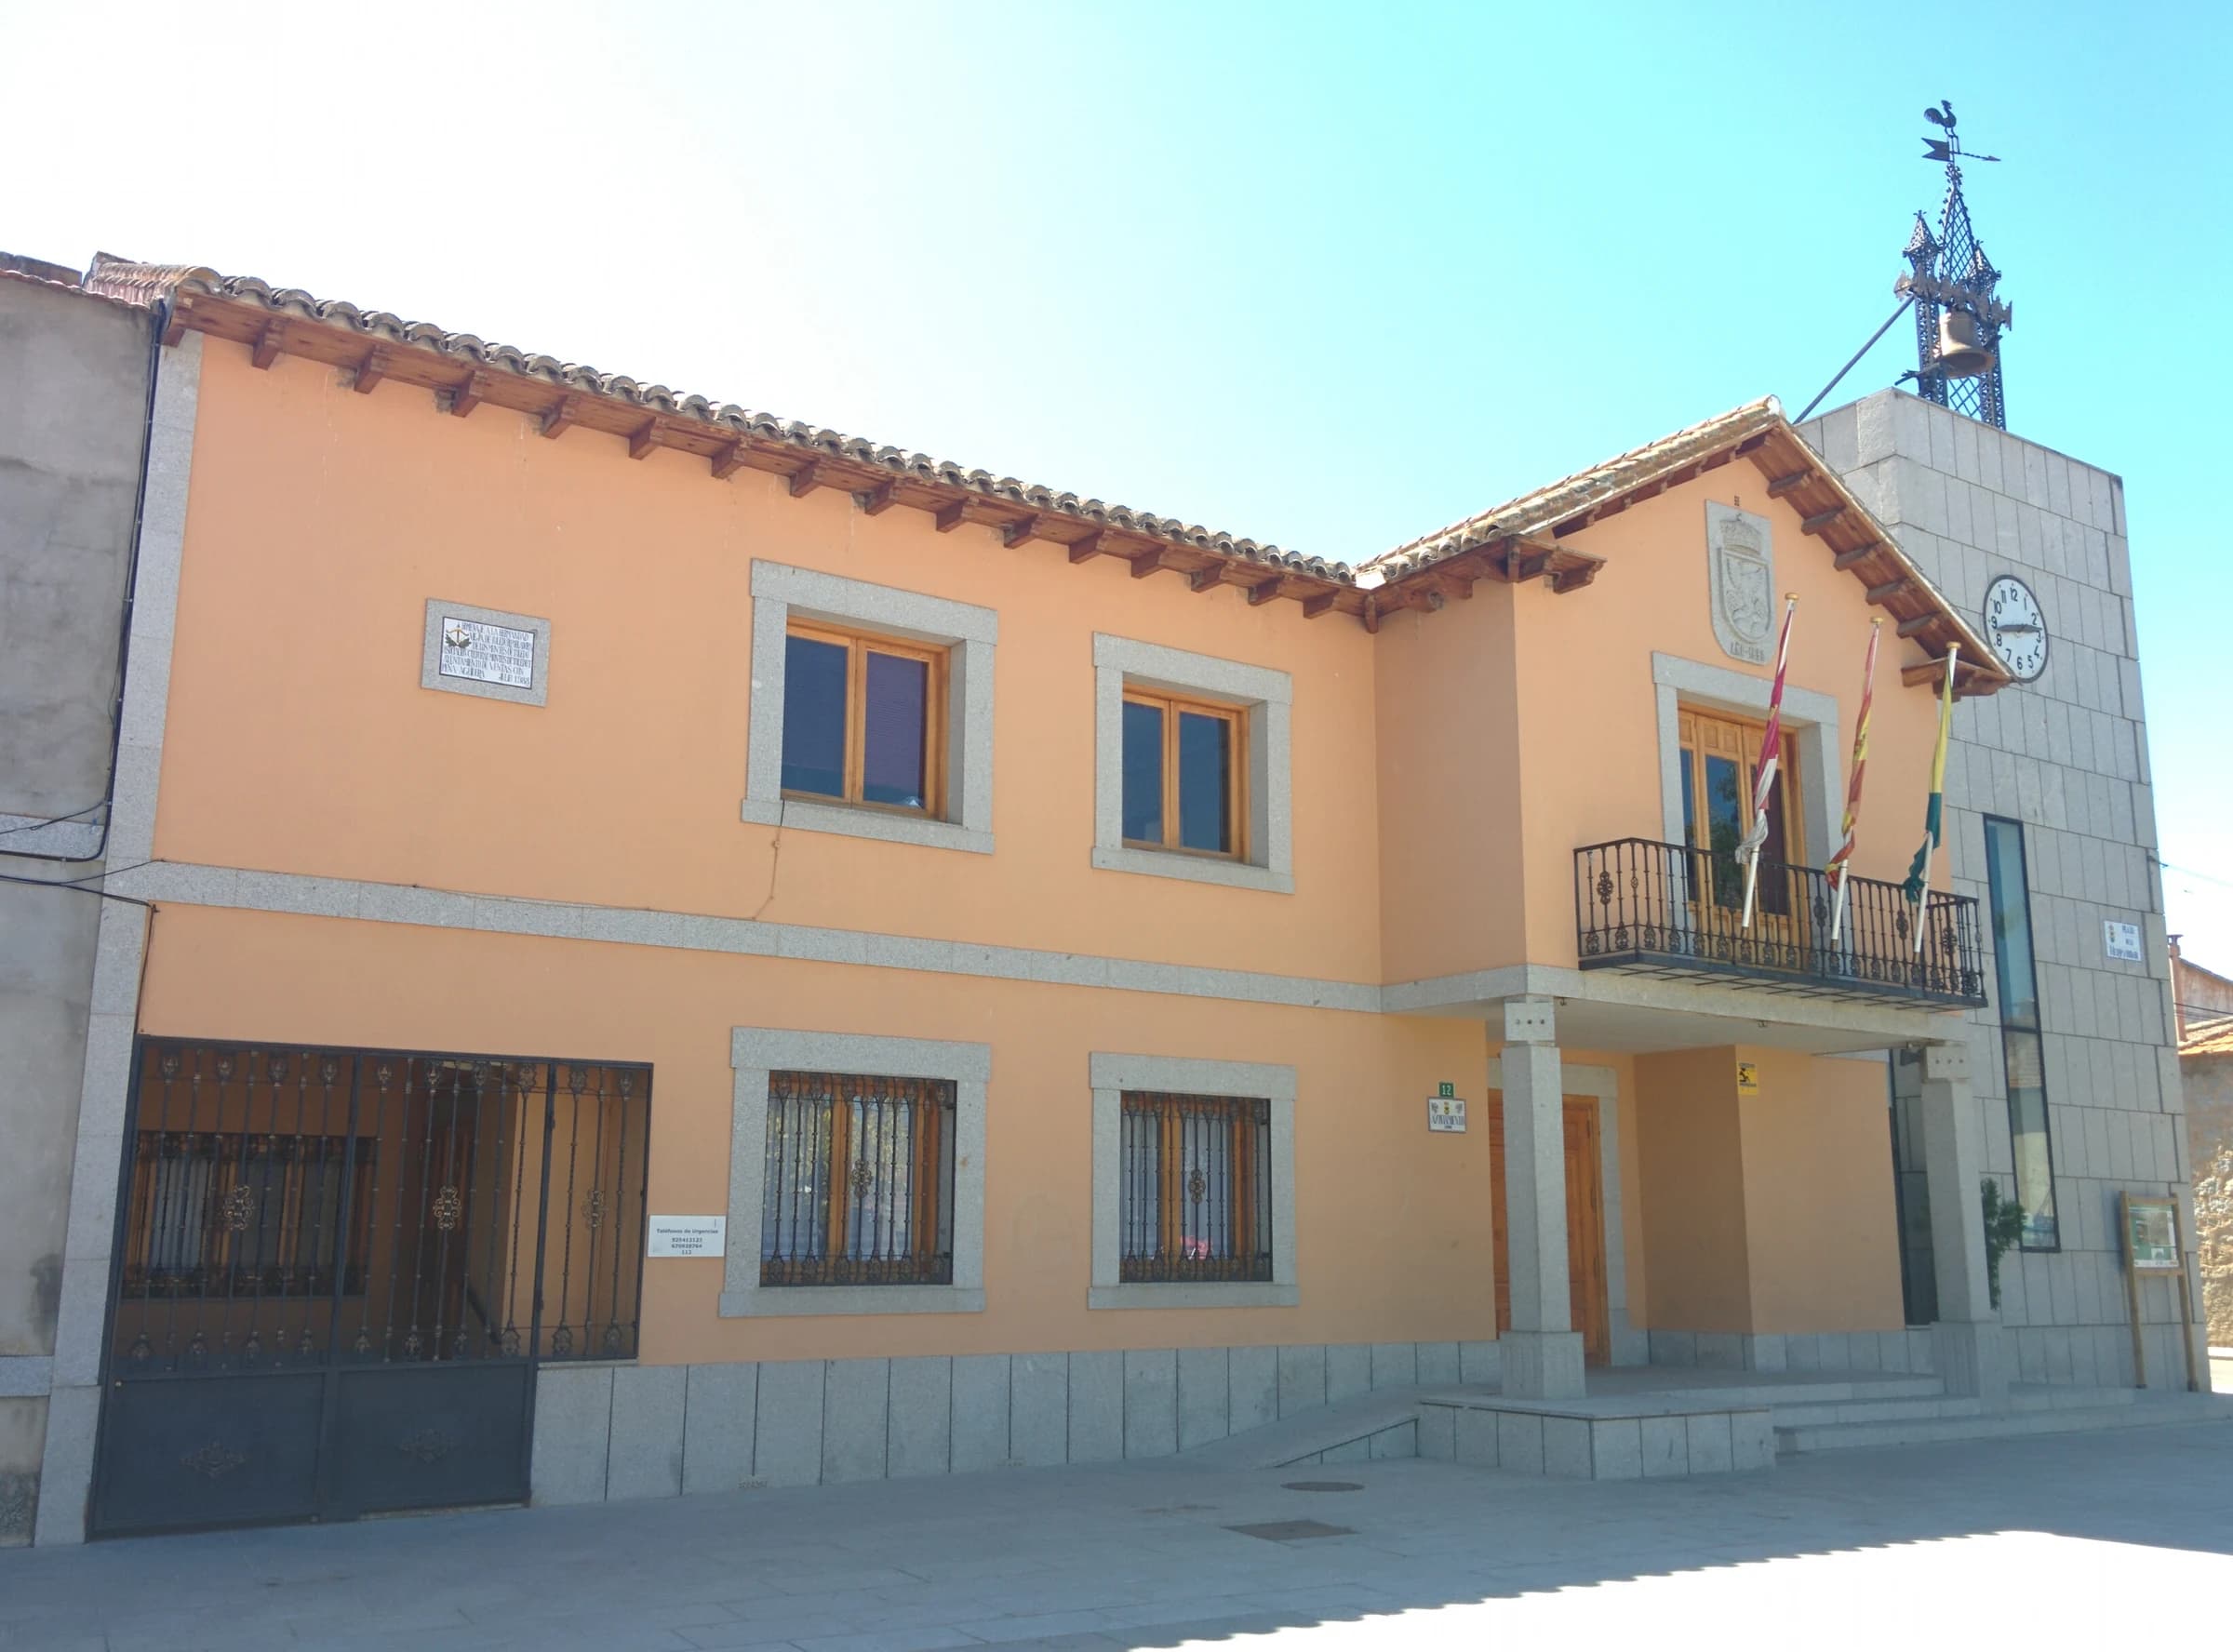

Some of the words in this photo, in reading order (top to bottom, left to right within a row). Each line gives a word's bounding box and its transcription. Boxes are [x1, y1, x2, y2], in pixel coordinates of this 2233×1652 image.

[2000, 589, 2007, 604] 11
[2010, 587, 2018, 603] 12
[1993, 600, 2002, 615] 10
[1991, 616, 1998, 630] 9
[2031, 612, 2038, 626] 2
[1996, 633, 2002, 646] 8
[2036, 630, 2041, 644] 3
[2005, 648, 2012, 663] 7
[2034, 645, 2039, 659] 4
[2016, 657, 2023, 670] 6
[2027, 655, 2033, 669] 5
[1442, 1085, 1451, 1096] 12
